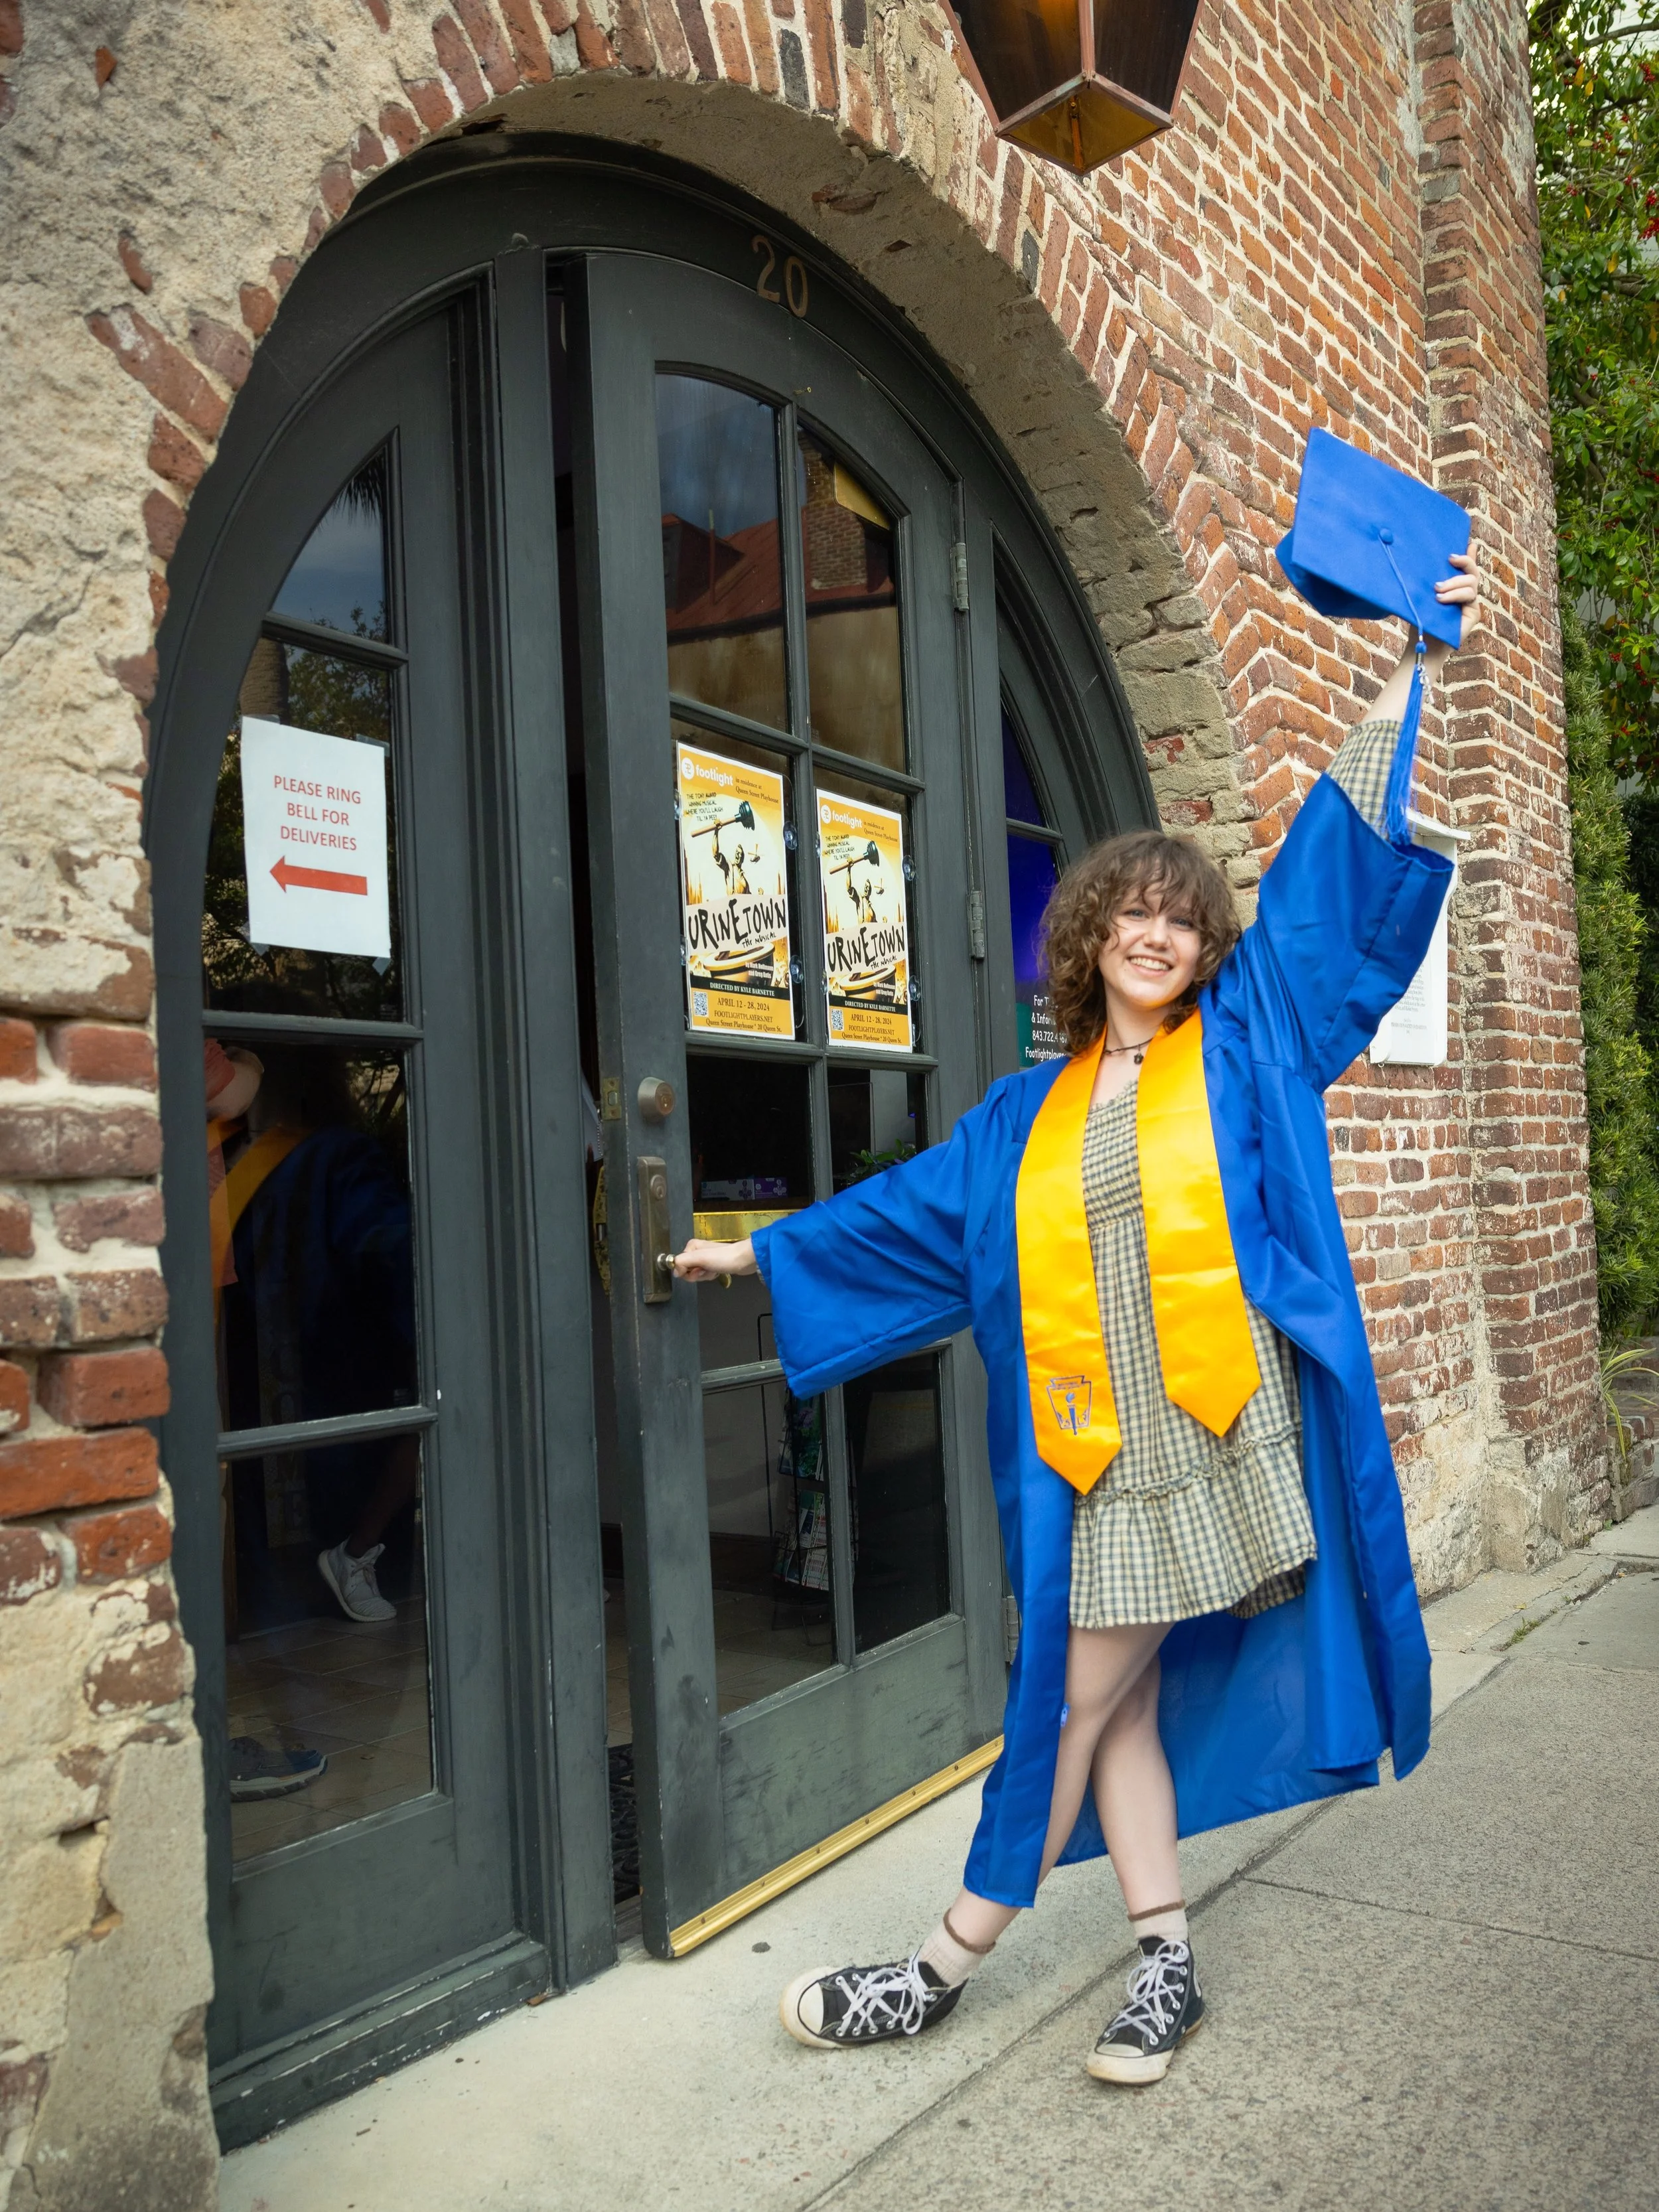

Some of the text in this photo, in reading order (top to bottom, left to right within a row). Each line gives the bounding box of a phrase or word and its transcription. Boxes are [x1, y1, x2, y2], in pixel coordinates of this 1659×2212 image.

[752, 234, 808, 317] 20
[695, 765, 733, 786] footlight
[740, 779, 758, 788] residence
[274, 775, 361, 804] PLEASE RING
[735, 786, 749, 795] Queen
[760, 792, 779, 804] Playhouse
[287, 802, 350, 826] BELL FOR
[832, 810, 863, 829] footlight
[281, 826, 356, 850] DELIVERIES
[688, 898, 786, 950] URINETOWN
[755, 932, 776, 945] MUSICAL
[828, 925, 904, 972] URINETOWN
[710, 982, 733, 992] DIRECTED
[717, 997, 735, 1007] APRIL
[757, 1003, 770, 1011] 2024
[1034, 995, 1043, 1006] For
[706, 1018, 719, 1027] Queen
[734, 1021, 754, 1030] Playhouse
[714, 1010, 773, 1023] FOOTLIGHTPLAYERS.NET
[851, 1013, 865, 1022] APRIL
[1031, 1012, 1035, 1023] &
[849, 1025, 895, 1035] FOOTLIGHTPLAYERS.NET
